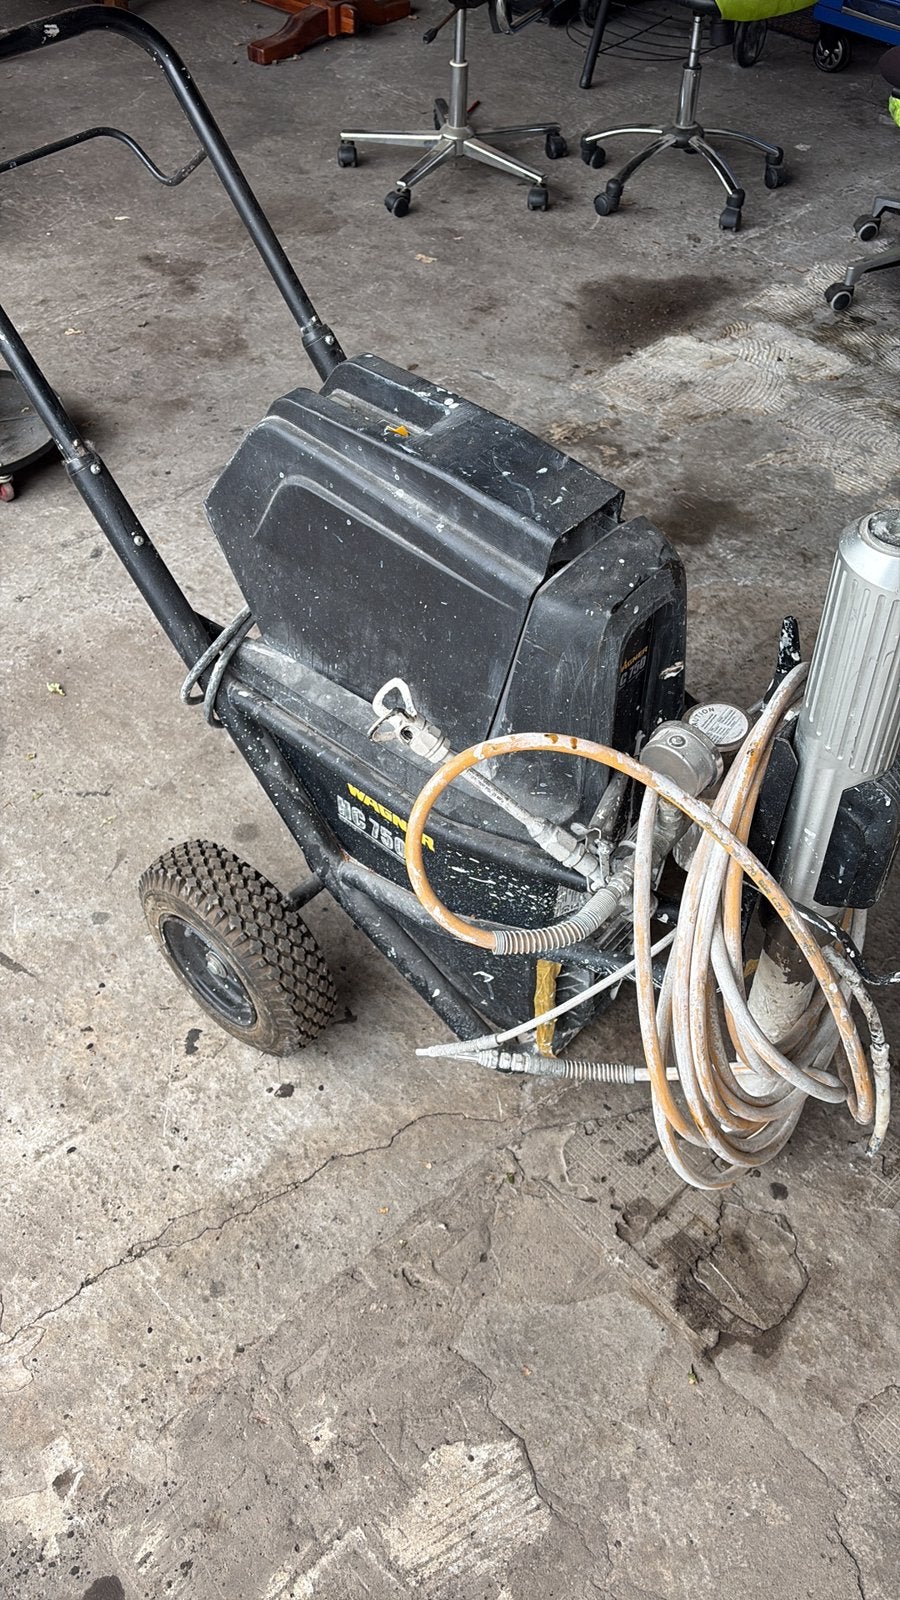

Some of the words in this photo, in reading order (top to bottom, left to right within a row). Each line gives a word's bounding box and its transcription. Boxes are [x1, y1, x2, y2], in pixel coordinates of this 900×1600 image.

[691, 706, 715, 728] AUTION
[336, 794, 367, 830] HC
[368, 817, 407, 859] 750
[346, 782, 436, 854] WAGNR
